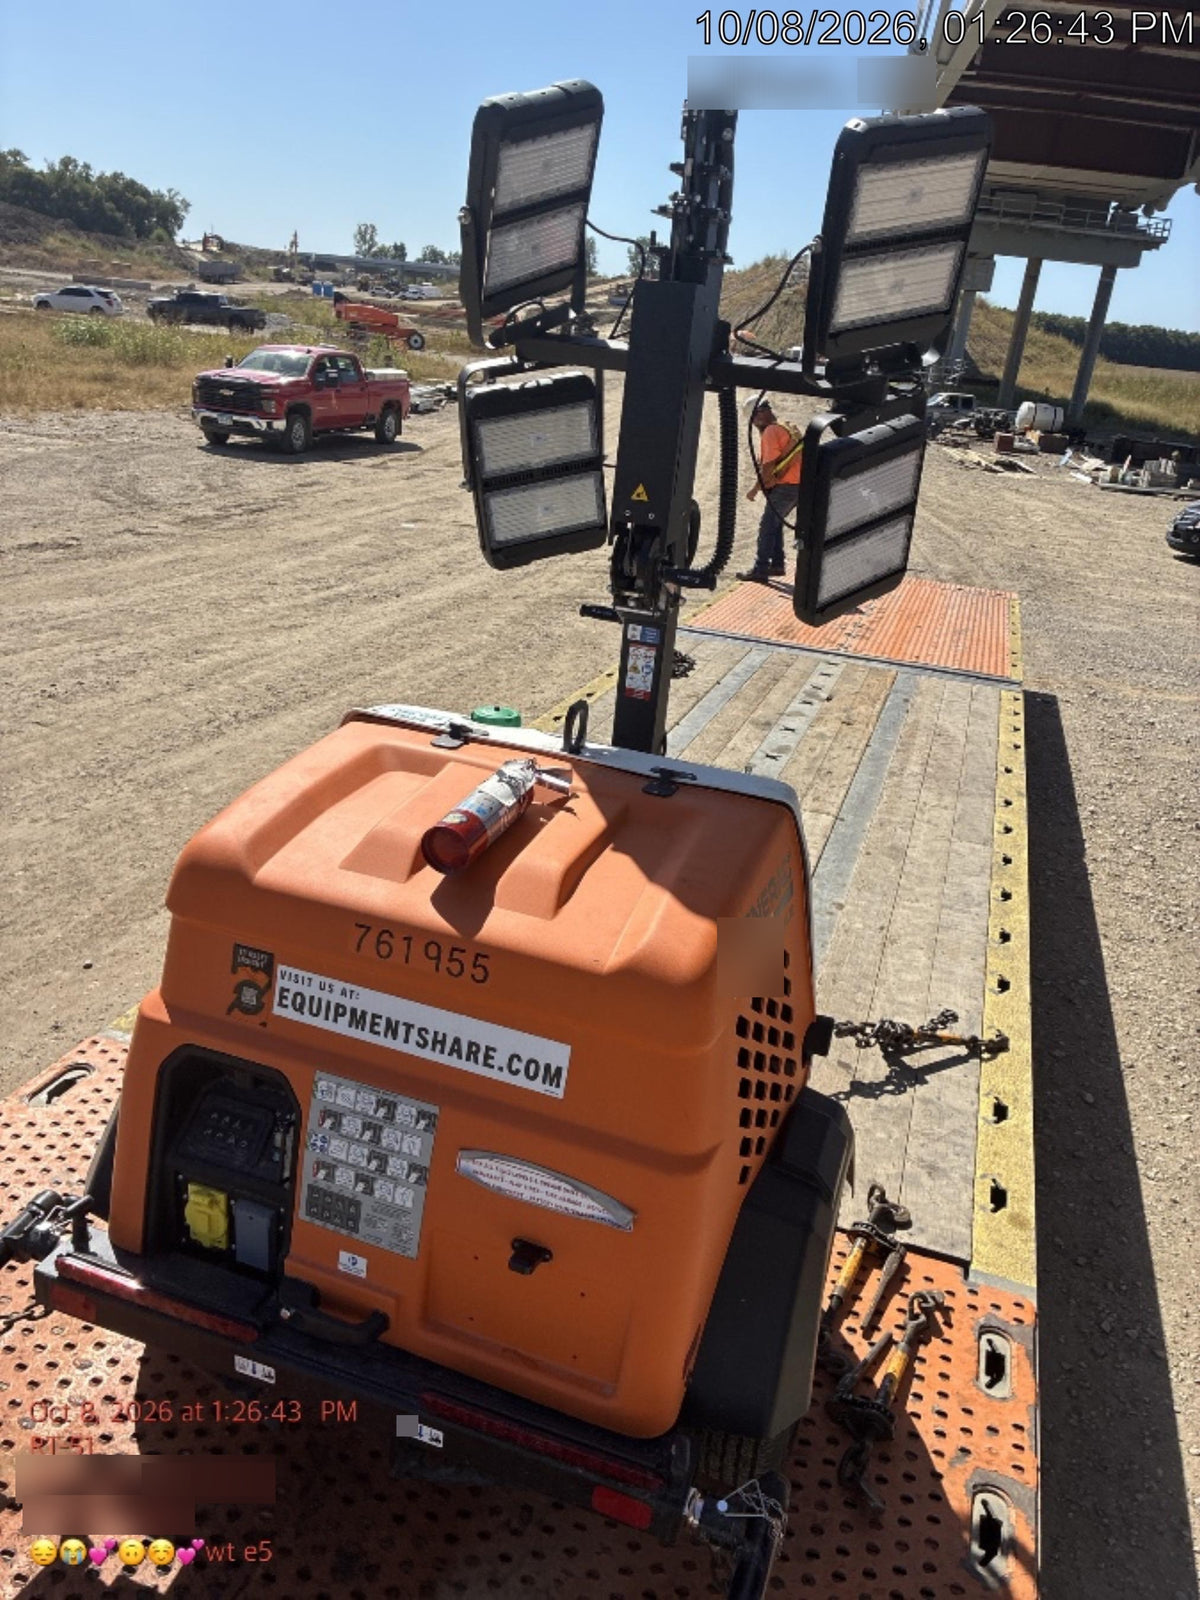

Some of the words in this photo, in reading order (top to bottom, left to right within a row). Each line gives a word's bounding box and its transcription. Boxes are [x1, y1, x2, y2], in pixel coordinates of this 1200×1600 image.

[355, 922, 490, 984] 761955
[280, 969, 313, 987] VISIT
[319, 980, 335, 994] US
[340, 986, 360, 1000] AT:
[277, 986, 564, 1089] EQUIPMENTSHARE.COM
